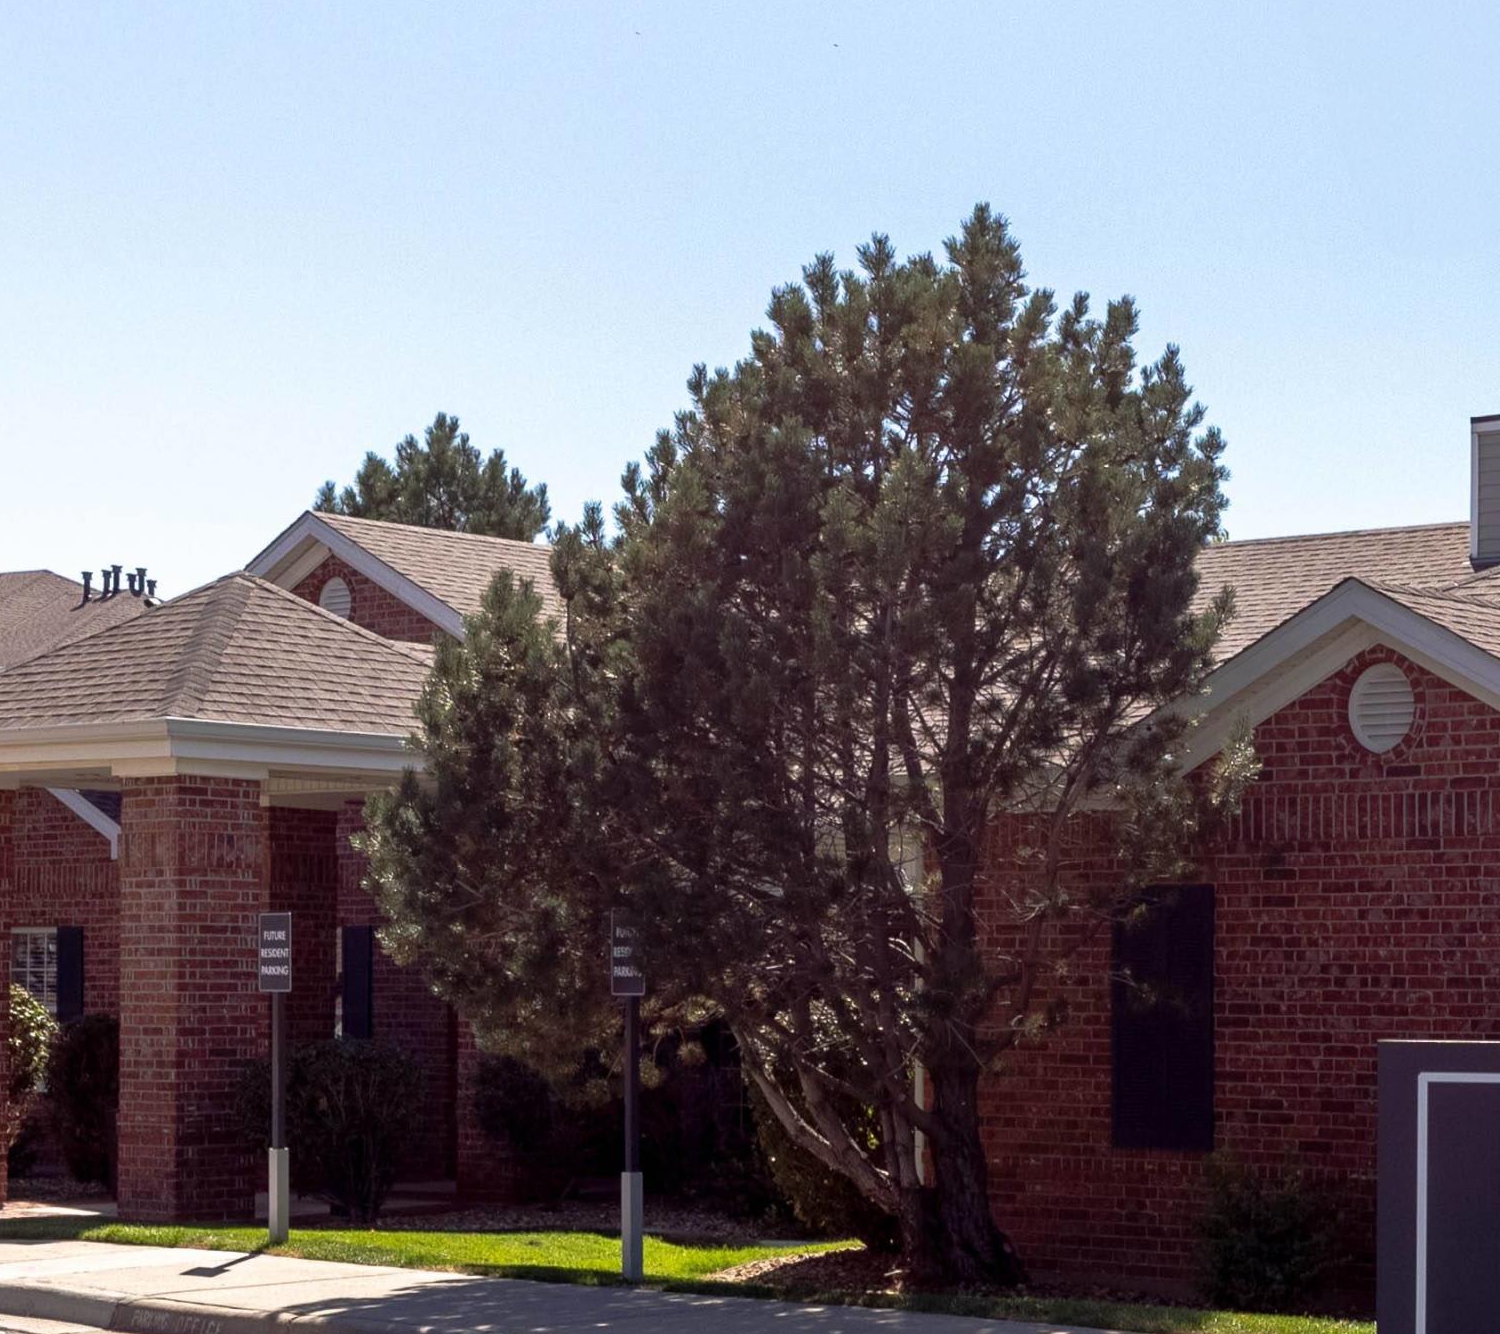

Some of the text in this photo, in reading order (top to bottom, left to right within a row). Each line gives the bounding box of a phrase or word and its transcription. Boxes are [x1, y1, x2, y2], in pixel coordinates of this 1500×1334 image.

[263, 930, 286, 941] FUTURE
[261, 948, 289, 958] RESIDENT
[261, 965, 289, 976] PARKING
